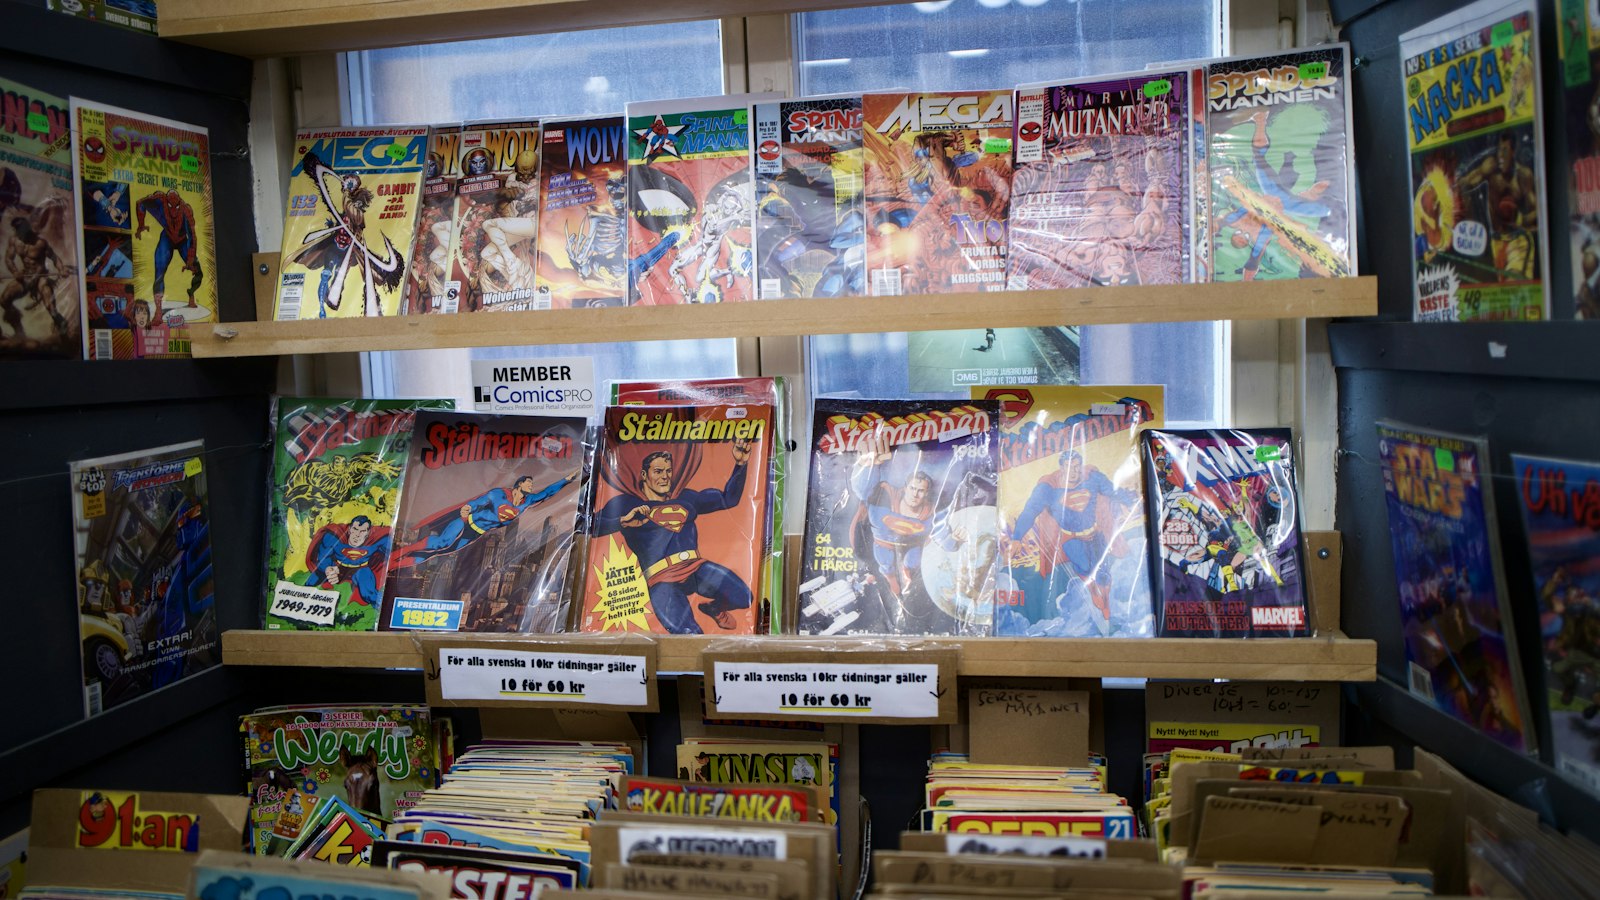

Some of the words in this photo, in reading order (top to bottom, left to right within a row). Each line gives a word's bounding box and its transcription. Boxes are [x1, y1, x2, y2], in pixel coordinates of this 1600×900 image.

[1209, 61, 1337, 99] SPINDL
[1209, 87, 1336, 112] MANNEN
[1409, 49, 1504, 145] NACKA
[877, 94, 1013, 133] MEGA
[313, 131, 356, 139] AVSLUTADE
[291, 136, 428, 177] MEGA
[137, 172, 159, 187] SECRET
[377, 182, 417, 196] GAMBIT
[291, 194, 318, 209] 132
[383, 204, 405, 212] EGEN
[379, 212, 408, 220] HAND!
[482, 288, 531, 305] Wolverine
[493, 365, 571, 382] MEMBER
[514, 403, 544, 411] Professional
[560, 403, 593, 411] Organization
[618, 412, 766, 443] Stålmannen
[424, 421, 573, 470] Stålmannen
[112, 459, 185, 491] TRANSFORME
[1393, 469, 1466, 520] WARS
[1166, 521, 1189, 532] 238
[815, 533, 831, 545] 64
[1158, 533, 1198, 545] SIDOR!
[815, 546, 854, 559] SIDOR
[820, 557, 858, 572] FÄRG!
[605, 566, 635, 580] JÄTTE
[606, 575, 636, 588] ALBUM
[603, 591, 645, 608] spännande
[607, 590, 618, 598] 68
[618, 586, 637, 596] sidor
[275, 599, 332, 618] 1949-1979
[397, 600, 460, 611] PRESENTALBUM
[609, 600, 639, 612] äventyr
[1167, 601, 1224, 616] MASSOR
[402, 610, 449, 627] 1982
[608, 611, 623, 620] helt
[627, 607, 645, 616] färg
[1251, 606, 1303, 625] MARVEL
[1167, 616, 1250, 631] MUTANTER!
[147, 629, 193, 651] EXTRA!
[160, 645, 180, 655] VINN
[447, 655, 463, 666] För
[467, 656, 485, 666] alla
[488, 658, 526, 668] svenska
[530, 658, 554, 669] 10kr
[557, 659, 604, 672] tidningar
[607, 661, 637, 673] gäller
[723, 671, 740, 682] För
[744, 672, 763, 682] alla
[766, 672, 807, 682] svenska
[812, 672, 838, 683] 10kr
[842, 672, 892, 684] tidningar
[895, 672, 927, 684] gäller
[500, 678, 517, 691] 10
[522, 678, 542, 692] för
[547, 680, 565, 693] 60
[569, 681, 585, 694] kr
[780, 693, 797, 706] 10
[803, 693, 825, 706] för
[830, 693, 849, 706] 60
[855, 693, 872, 706] kr
[332, 712, 363, 720] SERIER!
[1156, 727, 1176, 736] Nytt!
[1178, 728, 1198, 736] Nytt!
[1199, 729, 1219, 737] Nytt!
[273, 715, 411, 780] Wendy
[707, 753, 823, 786] KNASEN
[642, 788, 713, 817] KALLE
[719, 793, 794, 822] ANKA
[79, 793, 194, 849] 91:an
[1109, 819, 1131, 838] 21
